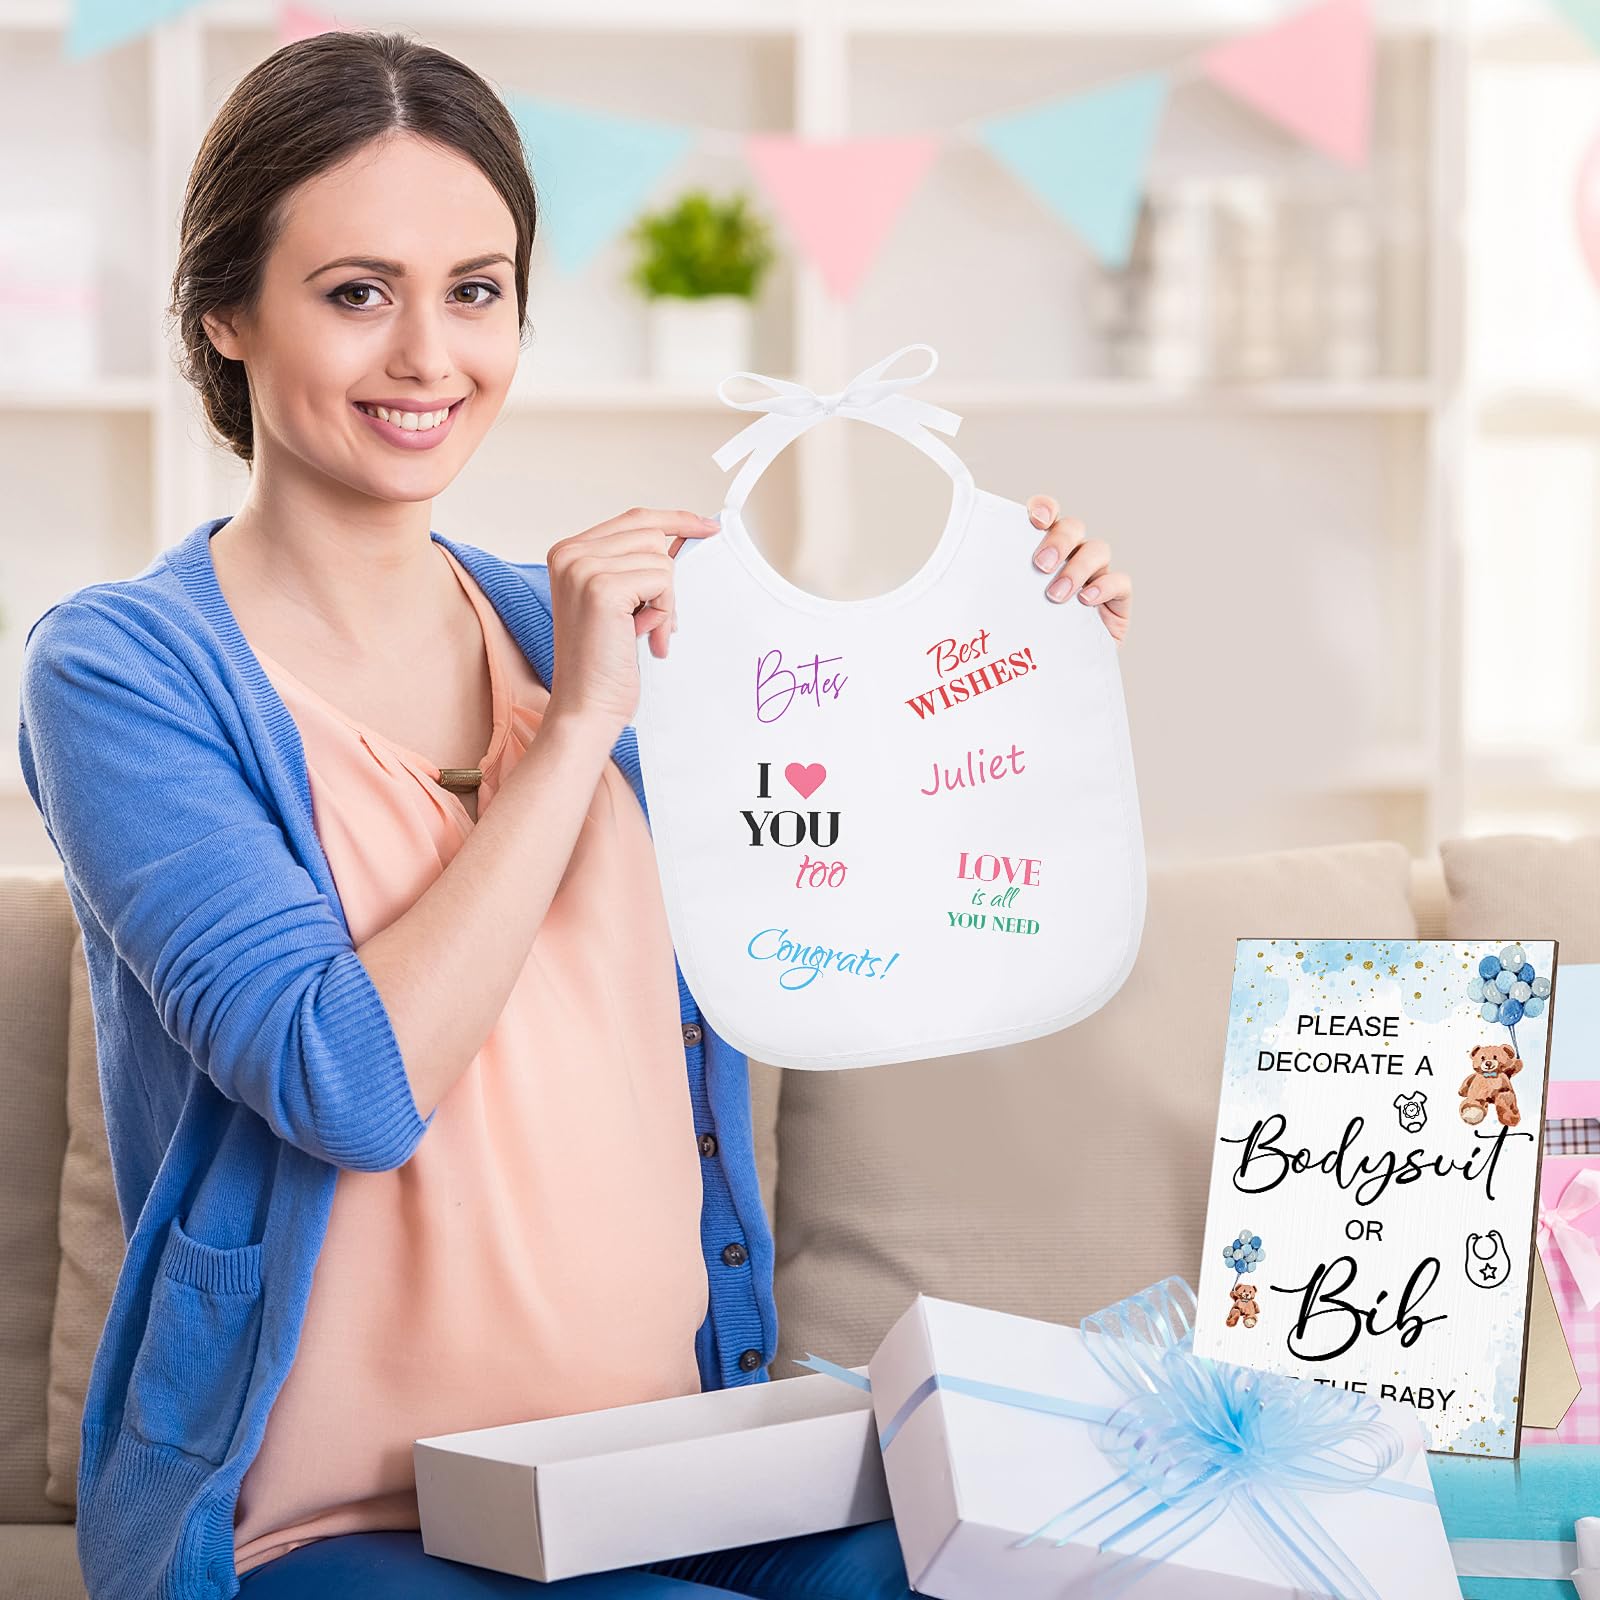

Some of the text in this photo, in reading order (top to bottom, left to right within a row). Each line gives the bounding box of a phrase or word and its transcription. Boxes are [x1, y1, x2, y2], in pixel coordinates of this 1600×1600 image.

[927, 629, 991, 678] Best
[756, 649, 848, 723] Bates
[905, 648, 1038, 720] WISHES!
[756, 762, 772, 799] I
[921, 744, 1026, 796] Juliet
[739, 810, 842, 848] YOU
[795, 854, 848, 889] too
[956, 852, 1042, 887] LOVE
[971, 886, 1020, 908] is all
[947, 911, 1040, 936] YOU NEED
[747, 928, 901, 991] Congrats!
[1296, 1014, 1400, 1038] PLEASE
[1257, 1050, 1434, 1076] DECORATE A
[1220, 1114, 1534, 1206] Bodysuit
[1345, 1219, 1384, 1242] OR
[1269, 1255, 1448, 1362] Bib
[1379, 1383, 1456, 1411] BABY
